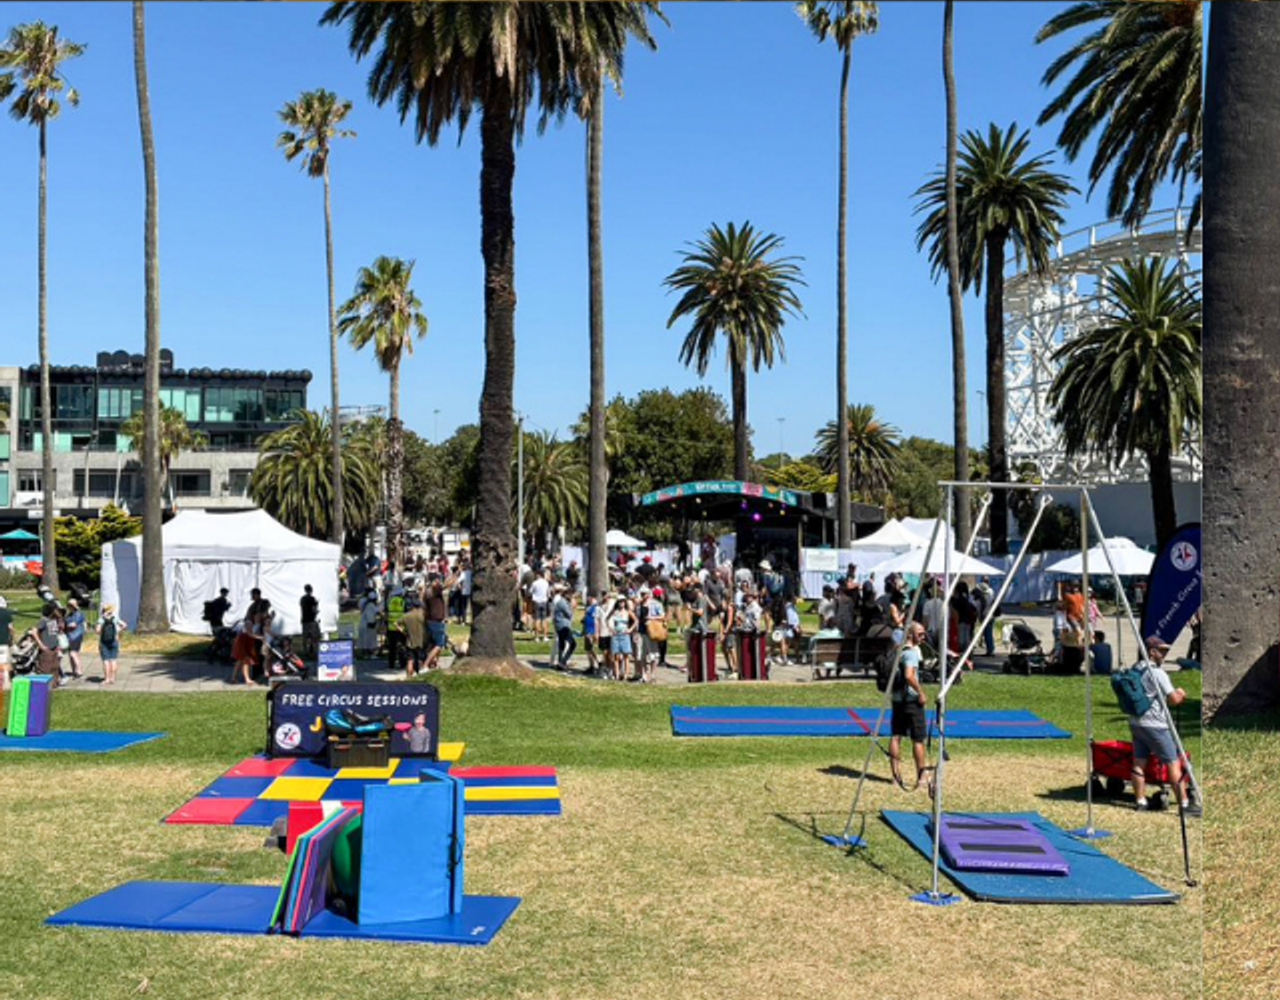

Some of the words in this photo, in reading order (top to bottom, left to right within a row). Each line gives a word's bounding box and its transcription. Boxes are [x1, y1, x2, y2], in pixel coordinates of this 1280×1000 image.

[282, 694, 313, 706] FREE
[318, 694, 362, 707] CIRCUS
[366, 694, 428, 707] SESSIONS
